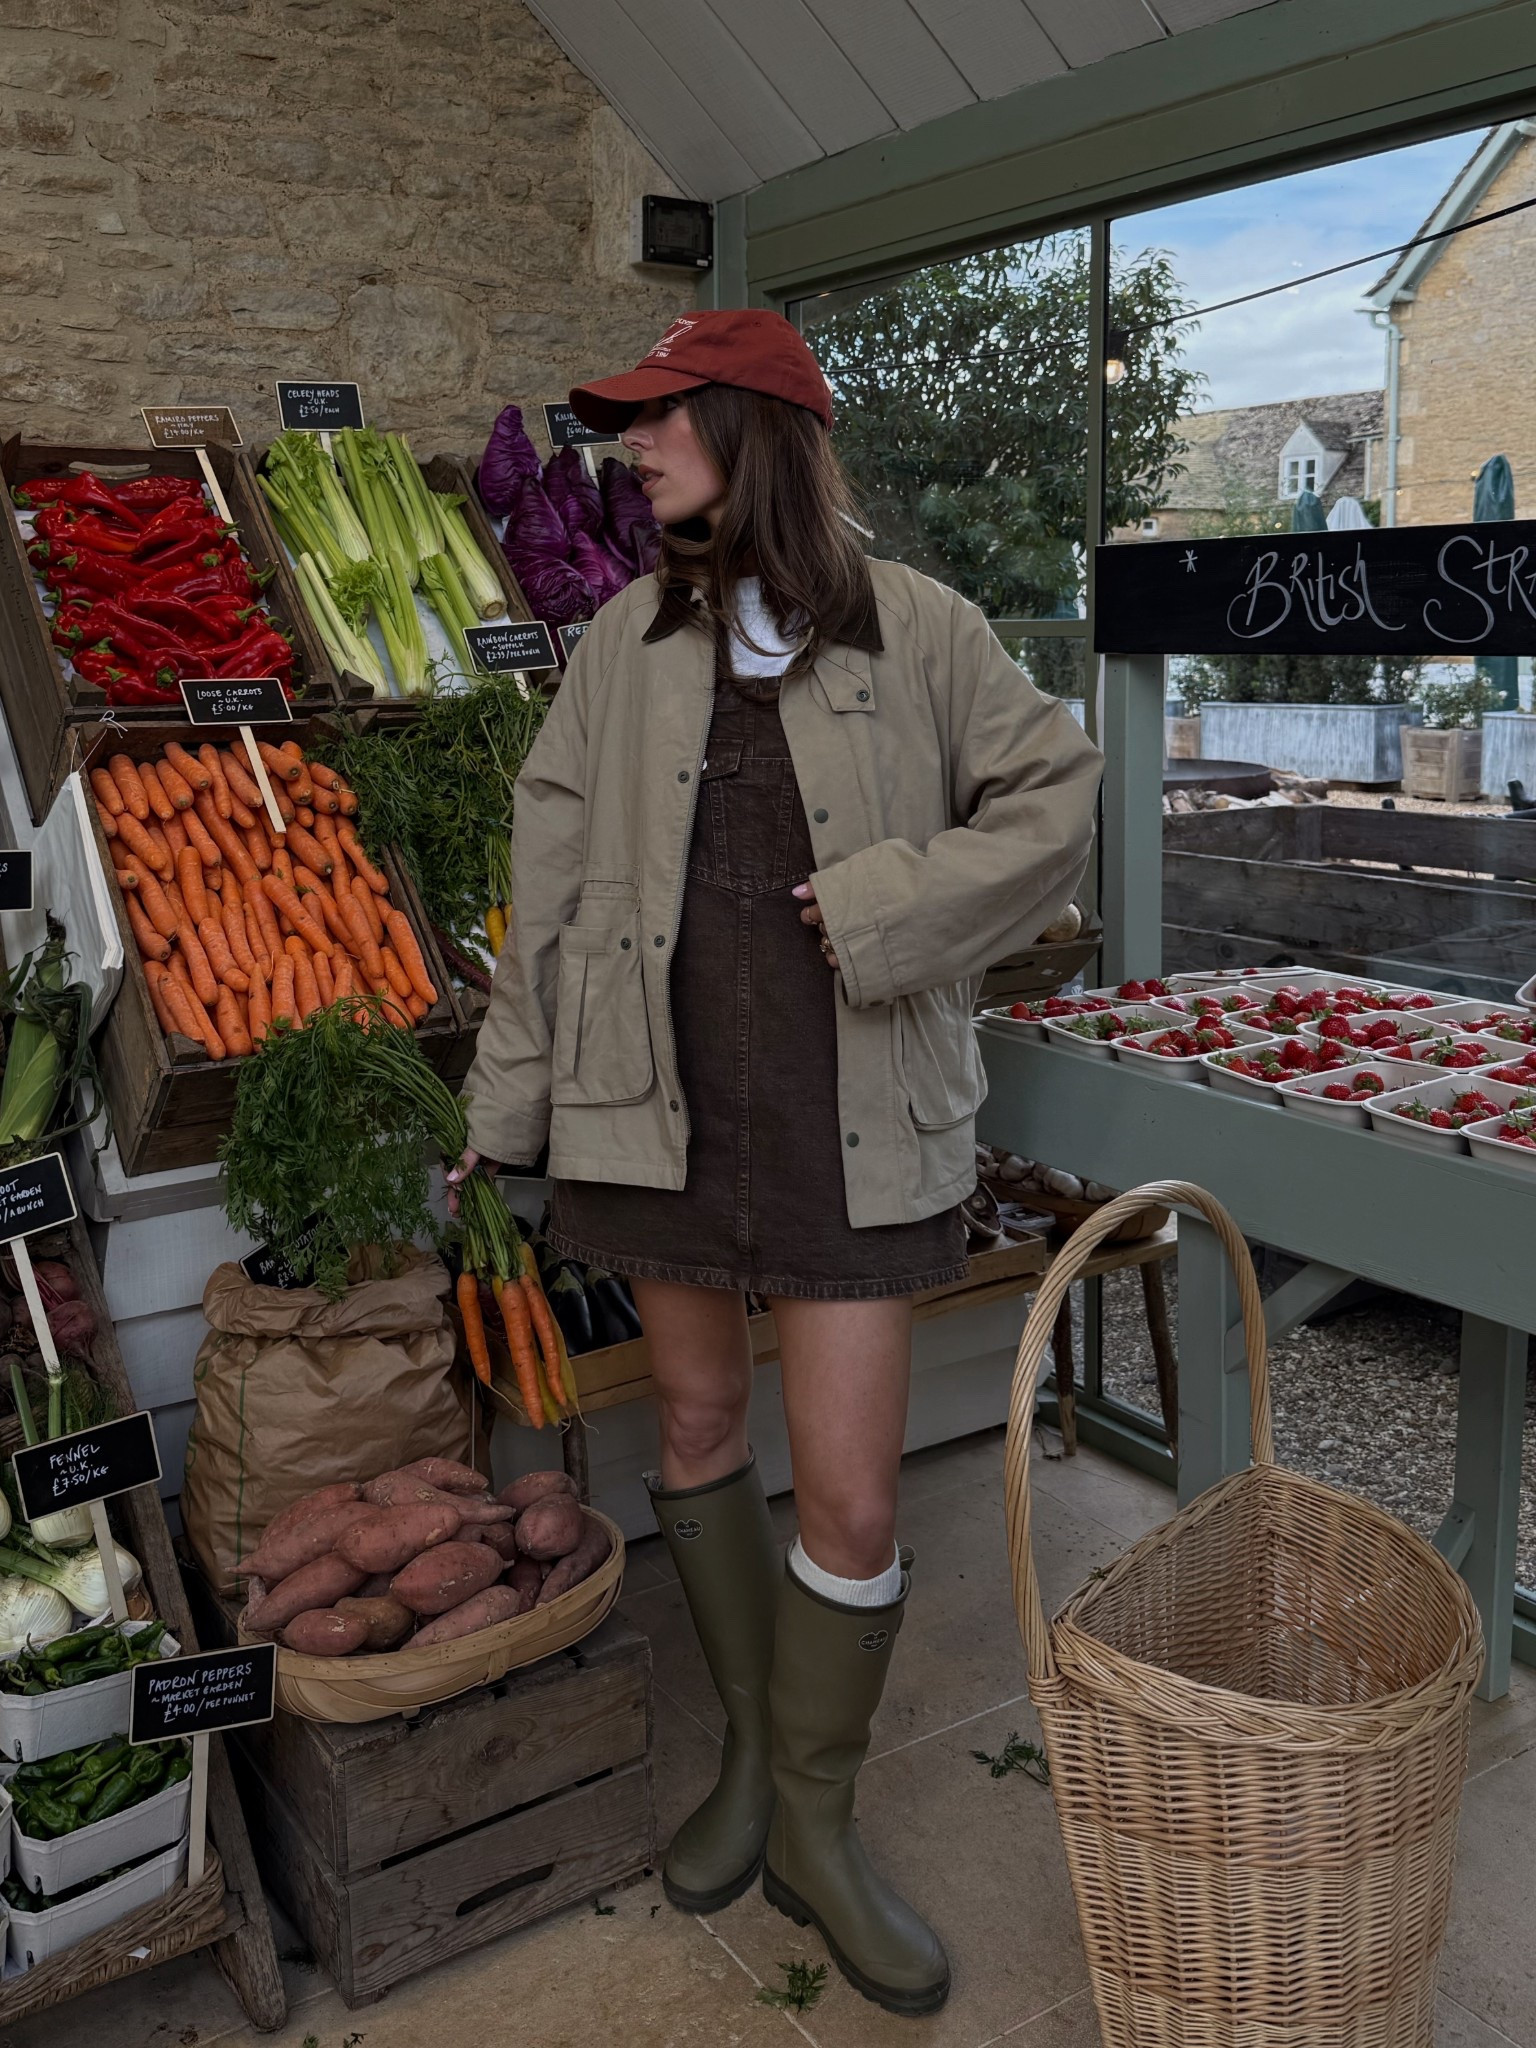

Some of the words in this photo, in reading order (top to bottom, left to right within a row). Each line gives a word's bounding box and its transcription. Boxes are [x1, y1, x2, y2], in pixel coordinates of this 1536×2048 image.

[287, 389, 314, 401] CELERY
[316, 389, 340, 398] HEADS
[187, 414, 219, 422] PEPPERS
[476, 631, 508, 649] RAINBOW
[509, 631, 539, 643] CARROTS
[196, 689, 223, 700] LOOSE
[225, 687, 263, 696] CARROTS
[10, 1183, 42, 1202] GARDEN
[49, 1444, 101, 1470] FENNEL
[52, 1465, 110, 1497] £7.50/KG
[148, 1669, 200, 1695] PADRON
[201, 1662, 253, 1684] PEPPERS
[203, 1678, 243, 1695] GARDEN
[222, 1691, 256, 1706] PUNNET
